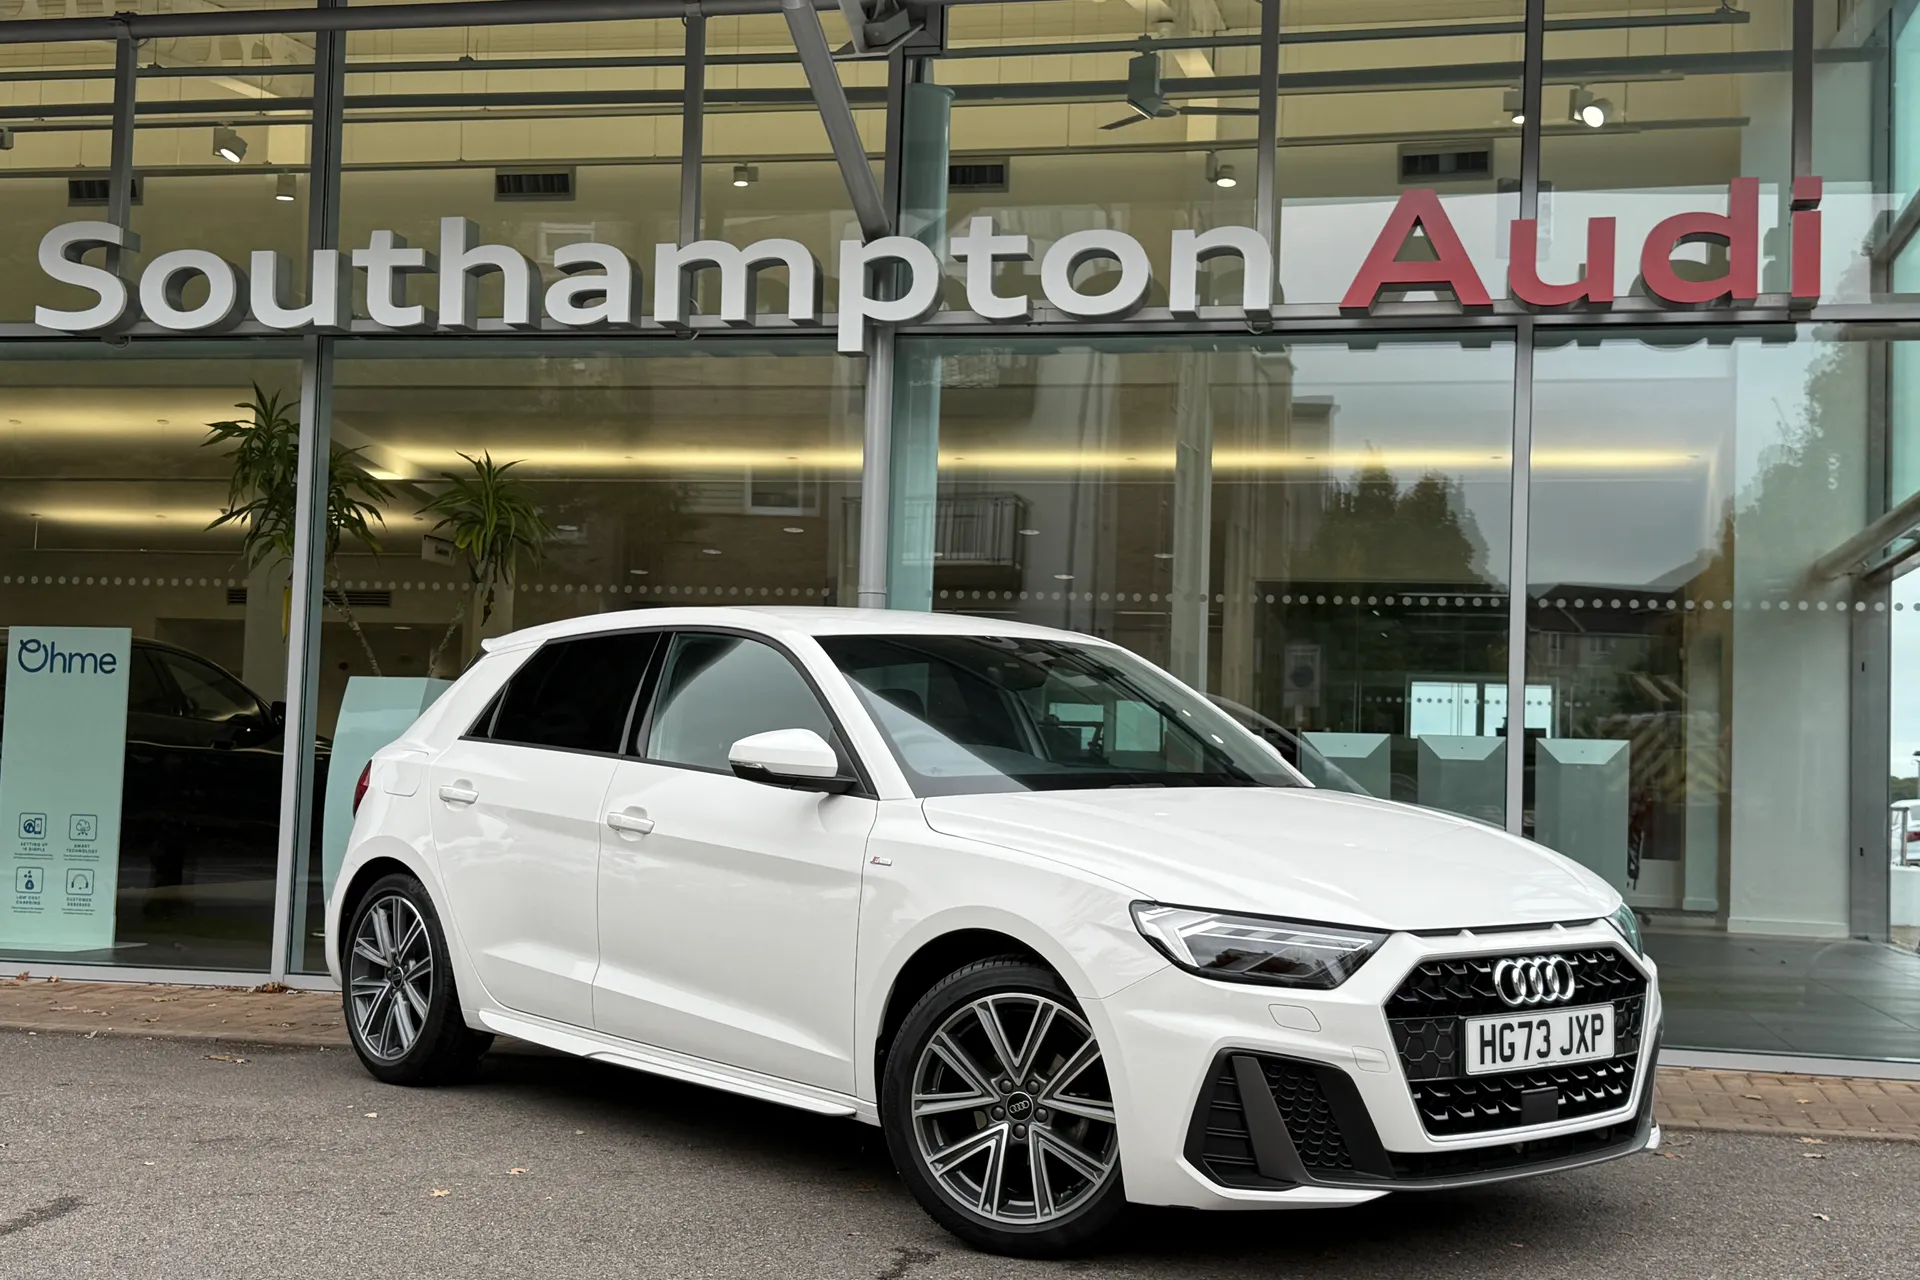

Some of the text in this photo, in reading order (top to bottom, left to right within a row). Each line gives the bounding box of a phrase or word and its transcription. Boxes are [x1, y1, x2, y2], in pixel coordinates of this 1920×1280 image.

[34, 176, 1823, 355] Southampton Audi
[18, 638, 117, 675] Ohme
[1479, 1013, 1604, 1065] HG73 JXP
